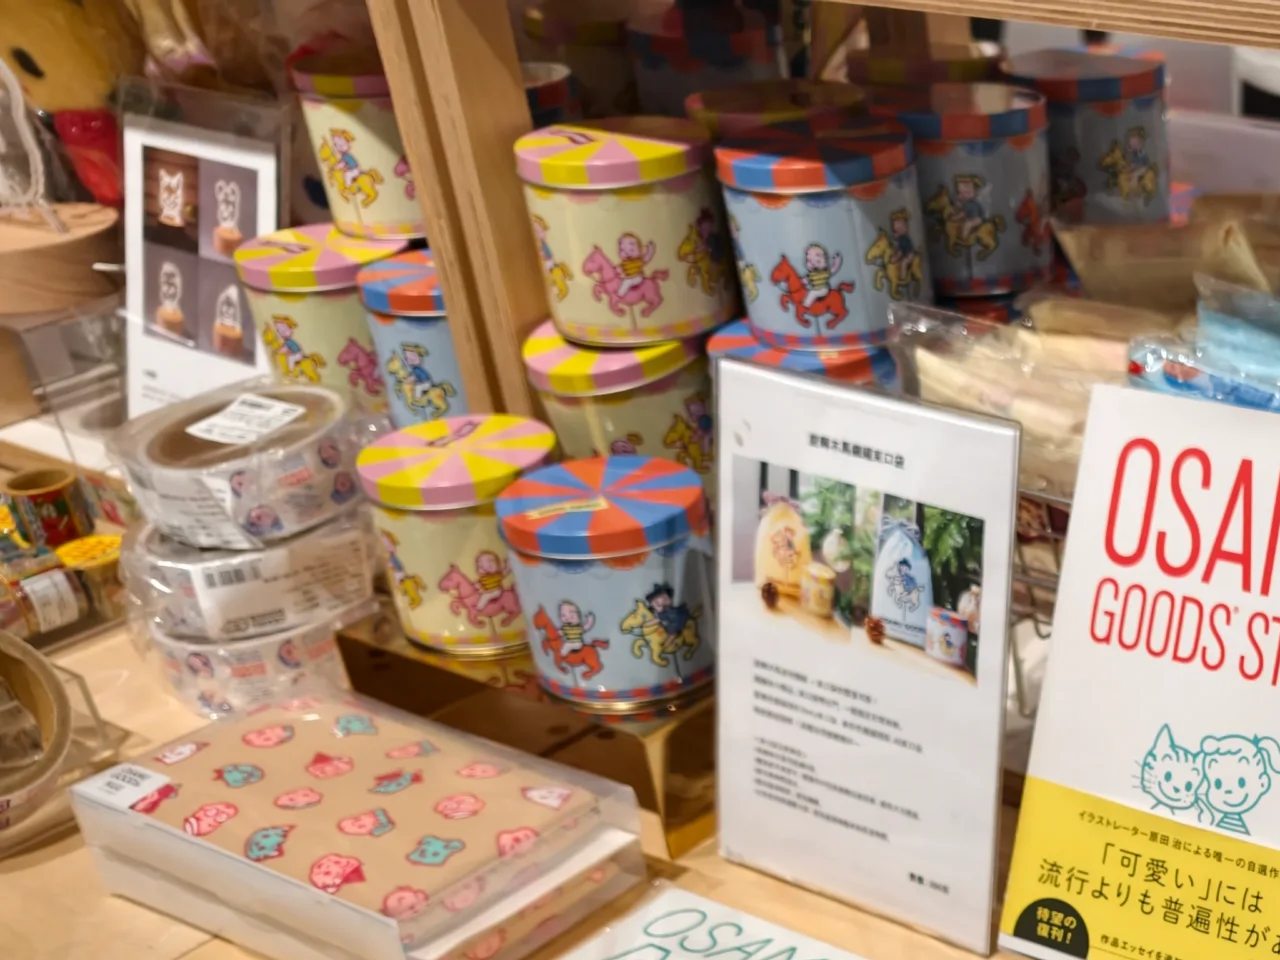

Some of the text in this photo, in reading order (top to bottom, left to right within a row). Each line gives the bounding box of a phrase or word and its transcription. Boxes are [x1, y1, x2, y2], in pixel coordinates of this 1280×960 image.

[1089, 577, 1231, 671] GOODS
[1101, 842, 1264, 914] 「可愛い」には
[1036, 905, 1077, 930] 待望の
